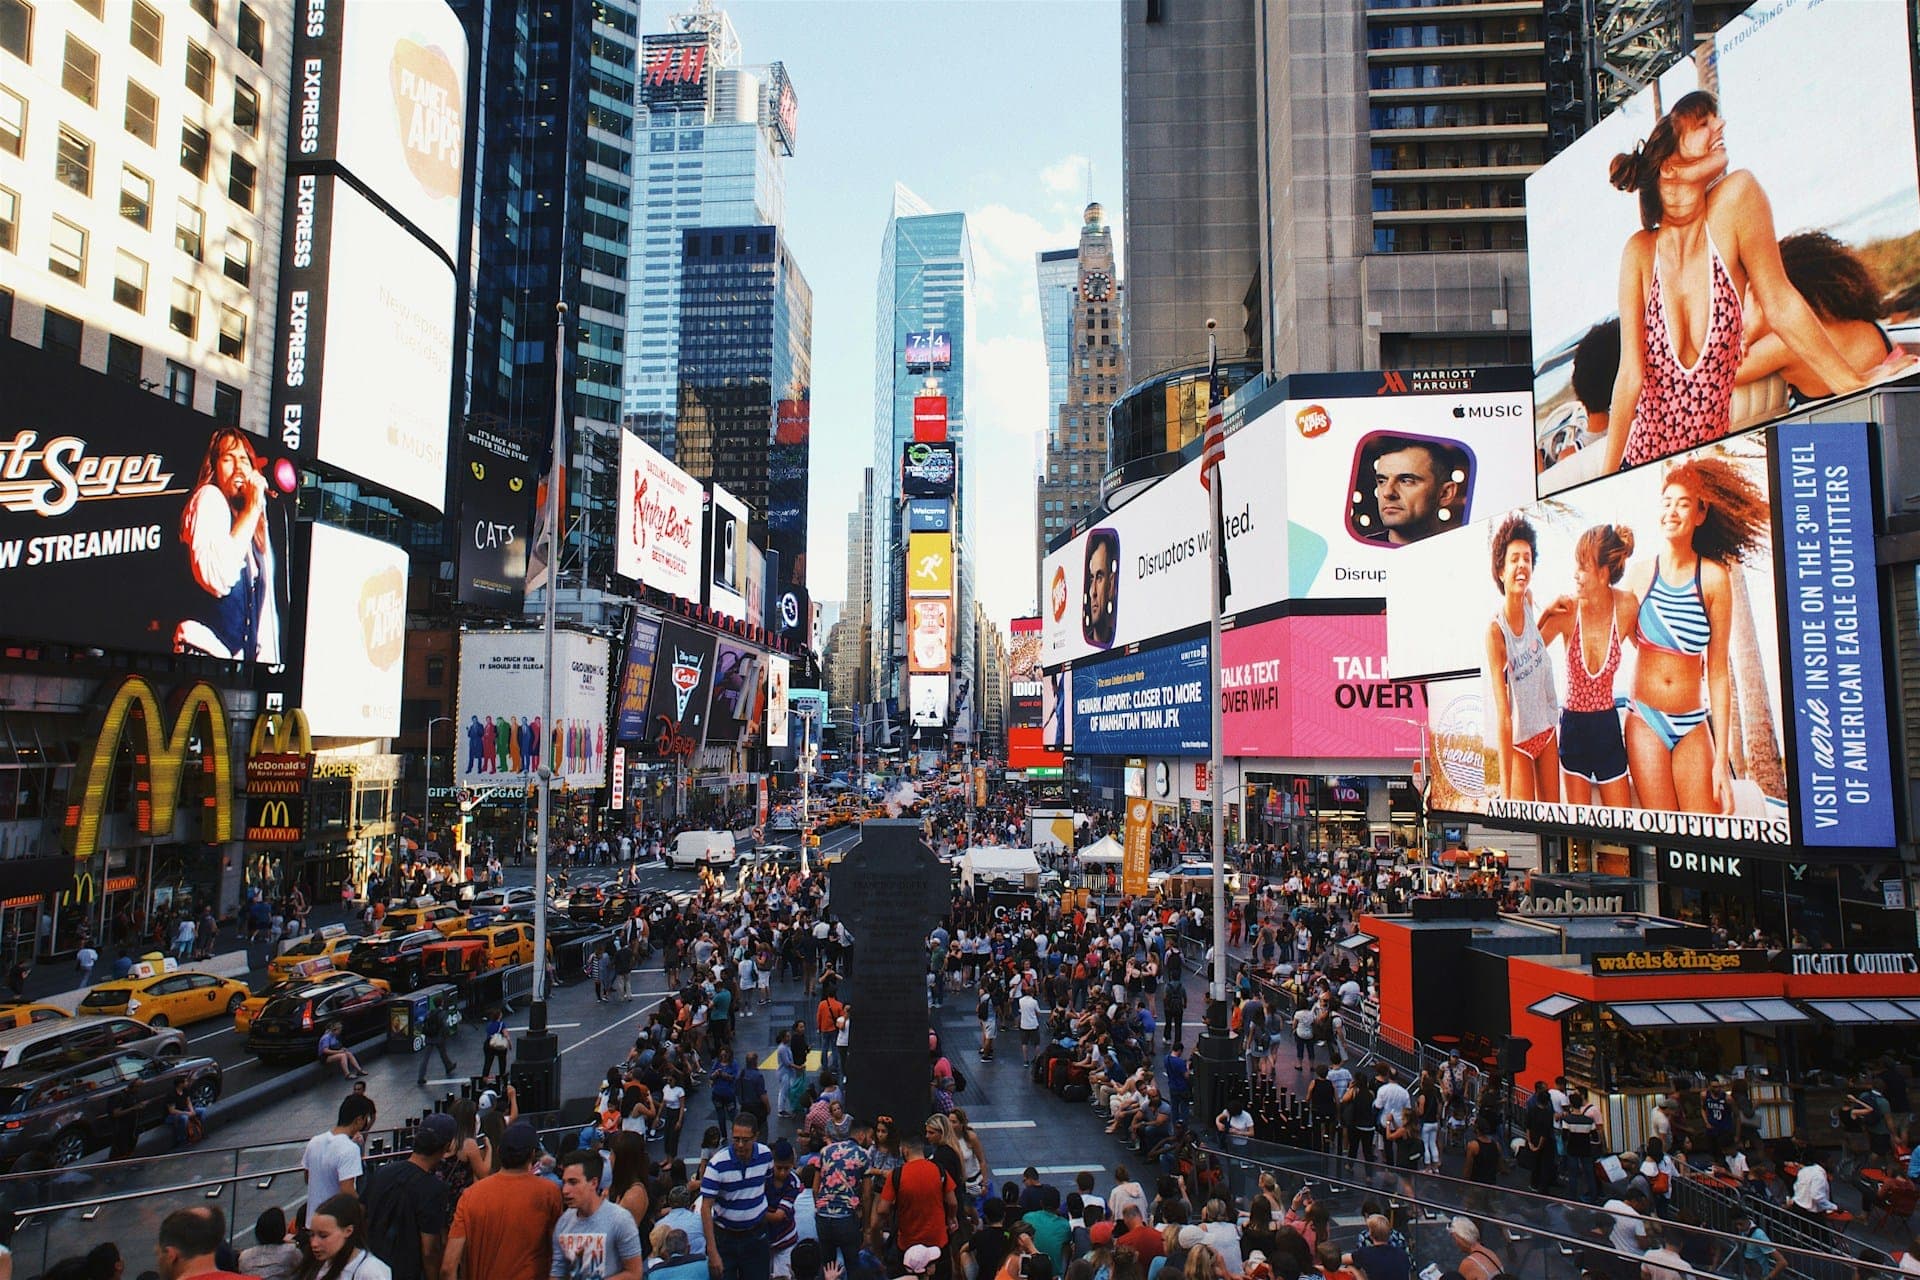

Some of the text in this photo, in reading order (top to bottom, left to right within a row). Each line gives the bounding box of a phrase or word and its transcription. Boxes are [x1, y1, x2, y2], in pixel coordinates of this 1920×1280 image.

[1723, 3, 1784, 54] RETOUCHING
[645, 46, 707, 87] H&M
[300, 59, 322, 153] EXPRESS
[400, 68, 448, 118] PLANET
[407, 103, 460, 169] APPS
[294, 175, 315, 267] EXPRESS
[287, 291, 308, 386] EXPRESS
[912, 335, 944, 348] 7:14
[1413, 369, 1477, 379] MARRIOTT
[1413, 381, 1470, 390] MARQUIS
[1303, 413, 1328, 433] APPS
[1468, 405, 1523, 418] MUSIC
[284, 404, 302, 450] EXP
[490, 434, 508, 447] BACK
[508, 441, 521, 452] AND
[492, 443, 511, 456] THAN
[37, 436, 173, 517] Seger
[633, 469, 692, 549] Kinky Boots
[27, 525, 161, 566] STREAMING
[474, 520, 515, 549] CATS
[1138, 536, 1195, 580] Disruptors
[671, 593, 789, 653] 1540 BROADWAY
[1791, 442, 1839, 828] VISIT aerie INSIDE ON THE 3RD LEVEL
[1825, 465, 1870, 803] OF AMERICAN EAGLE OUTFITTERS
[1181, 649, 1201, 660] UNITED
[582, 673, 593, 684] DAY
[1221, 659, 1280, 688] TALK & TEXT
[1077, 681, 1202, 715] NEWARK AIRPORT: CLOSER TO MORE
[1222, 687, 1278, 713] OVER WI-FI
[1336, 684, 1413, 709] OVER
[1090, 708, 1180, 732] OF MANHATTAN THAN JFK
[657, 714, 697, 763] Disney
[247, 761, 306, 770] McDonald's
[312, 763, 363, 779] EXPRESS
[1487, 801, 1790, 844] AMERICAN EAGLE OUTFITTERS
[1669, 850, 1742, 877] DRINK
[1598, 951, 1741, 971] wafels&dinges
[1793, 953, 1919, 975] MIGHTY QUINN'S
[1707, 1102, 1725, 1110] USA
[1712, 1110, 1722, 1121] 10
